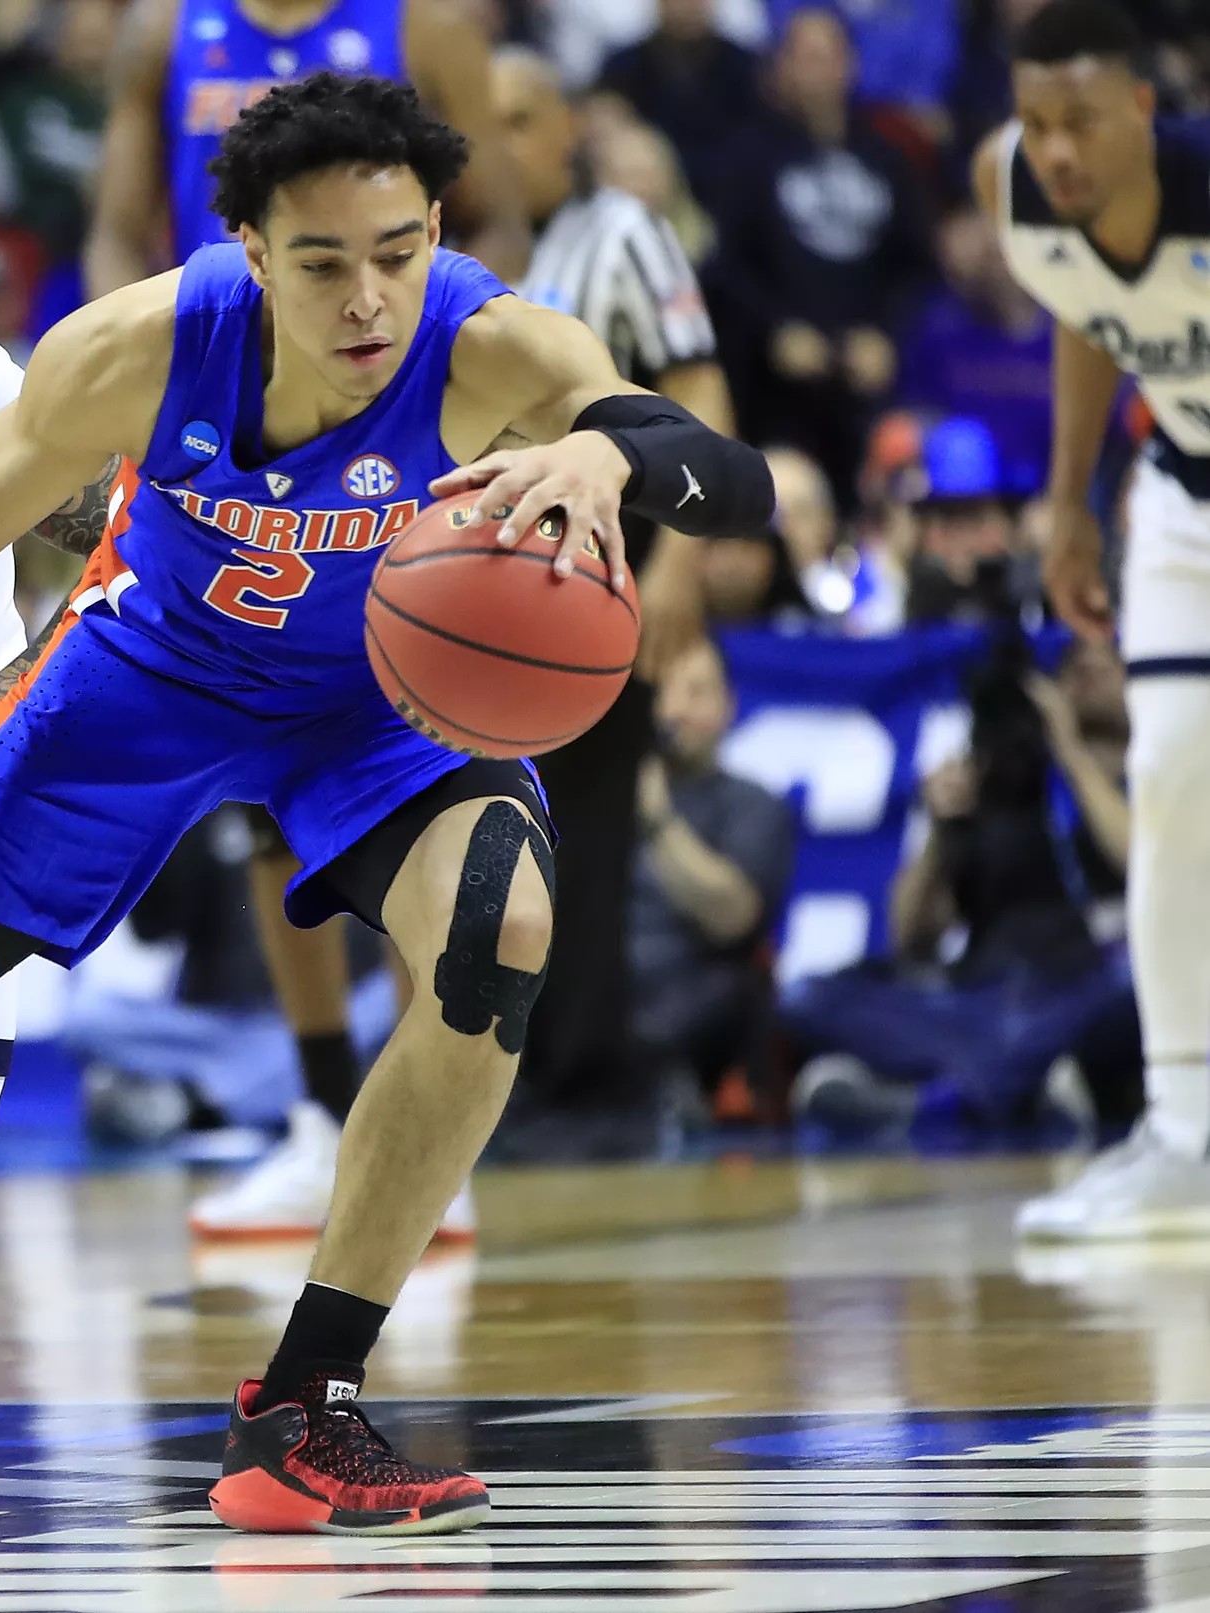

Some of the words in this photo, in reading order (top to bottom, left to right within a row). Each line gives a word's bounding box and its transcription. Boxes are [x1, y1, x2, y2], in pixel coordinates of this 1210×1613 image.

[183, 435, 218, 456] NCAA
[347, 457, 394, 496] SEC
[162, 486, 418, 553] LORIDA
[202, 547, 315, 629] 2
